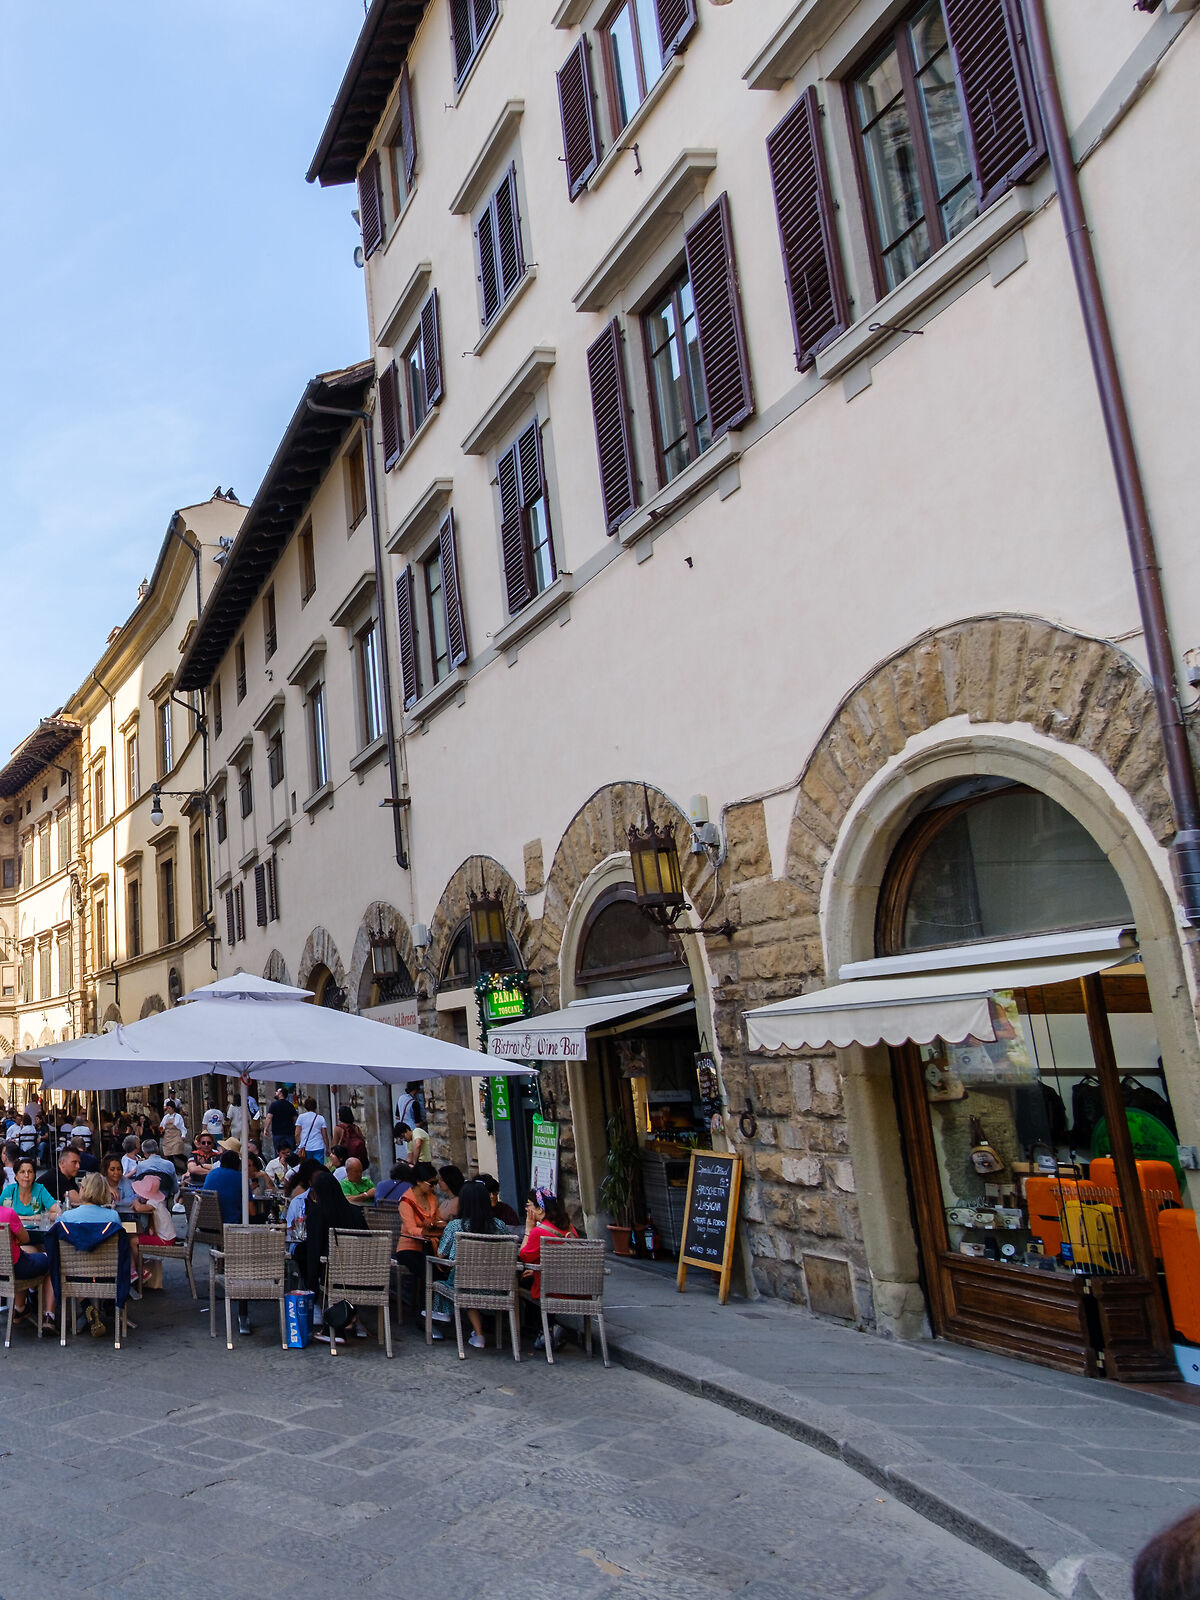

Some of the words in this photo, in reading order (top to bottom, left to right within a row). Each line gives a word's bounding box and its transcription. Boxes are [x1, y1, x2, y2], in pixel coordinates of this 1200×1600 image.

[498, 1005, 520, 1015] TOSCANI
[537, 1038, 558, 1056] Wine
[560, 1036, 580, 1056] Bar
[537, 1125, 554, 1135] PANINI
[535, 1136, 556, 1147] TOSCANI
[288, 1301, 296, 1319] AW
[290, 1322, 298, 1343] LAB
